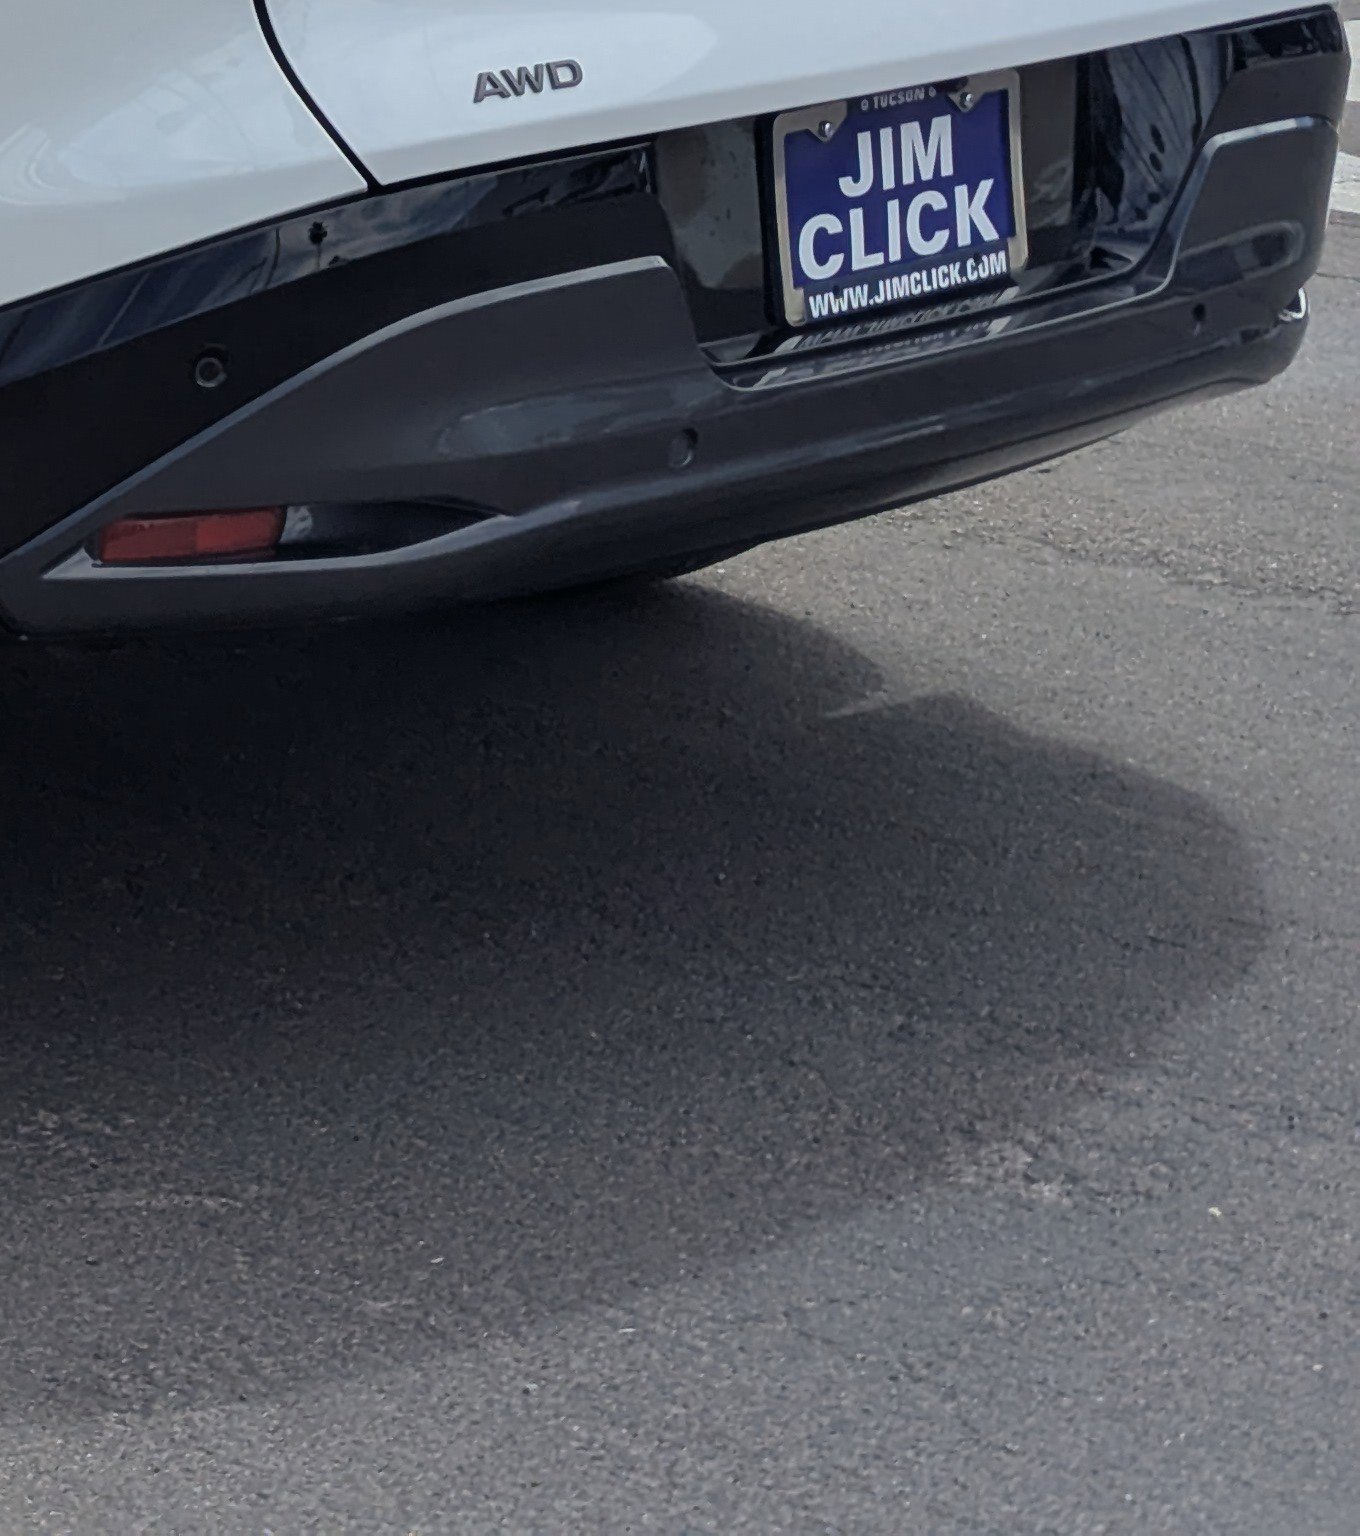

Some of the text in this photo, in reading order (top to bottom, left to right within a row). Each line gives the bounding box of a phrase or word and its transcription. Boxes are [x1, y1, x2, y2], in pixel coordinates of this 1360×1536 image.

[473, 59, 583, 104] AWD
[872, 87, 926, 110] TUCSON
[837, 114, 954, 198] JIM
[798, 178, 1000, 281] CLICK
[808, 250, 1007, 319] WWW.JIMCLICK.COM
